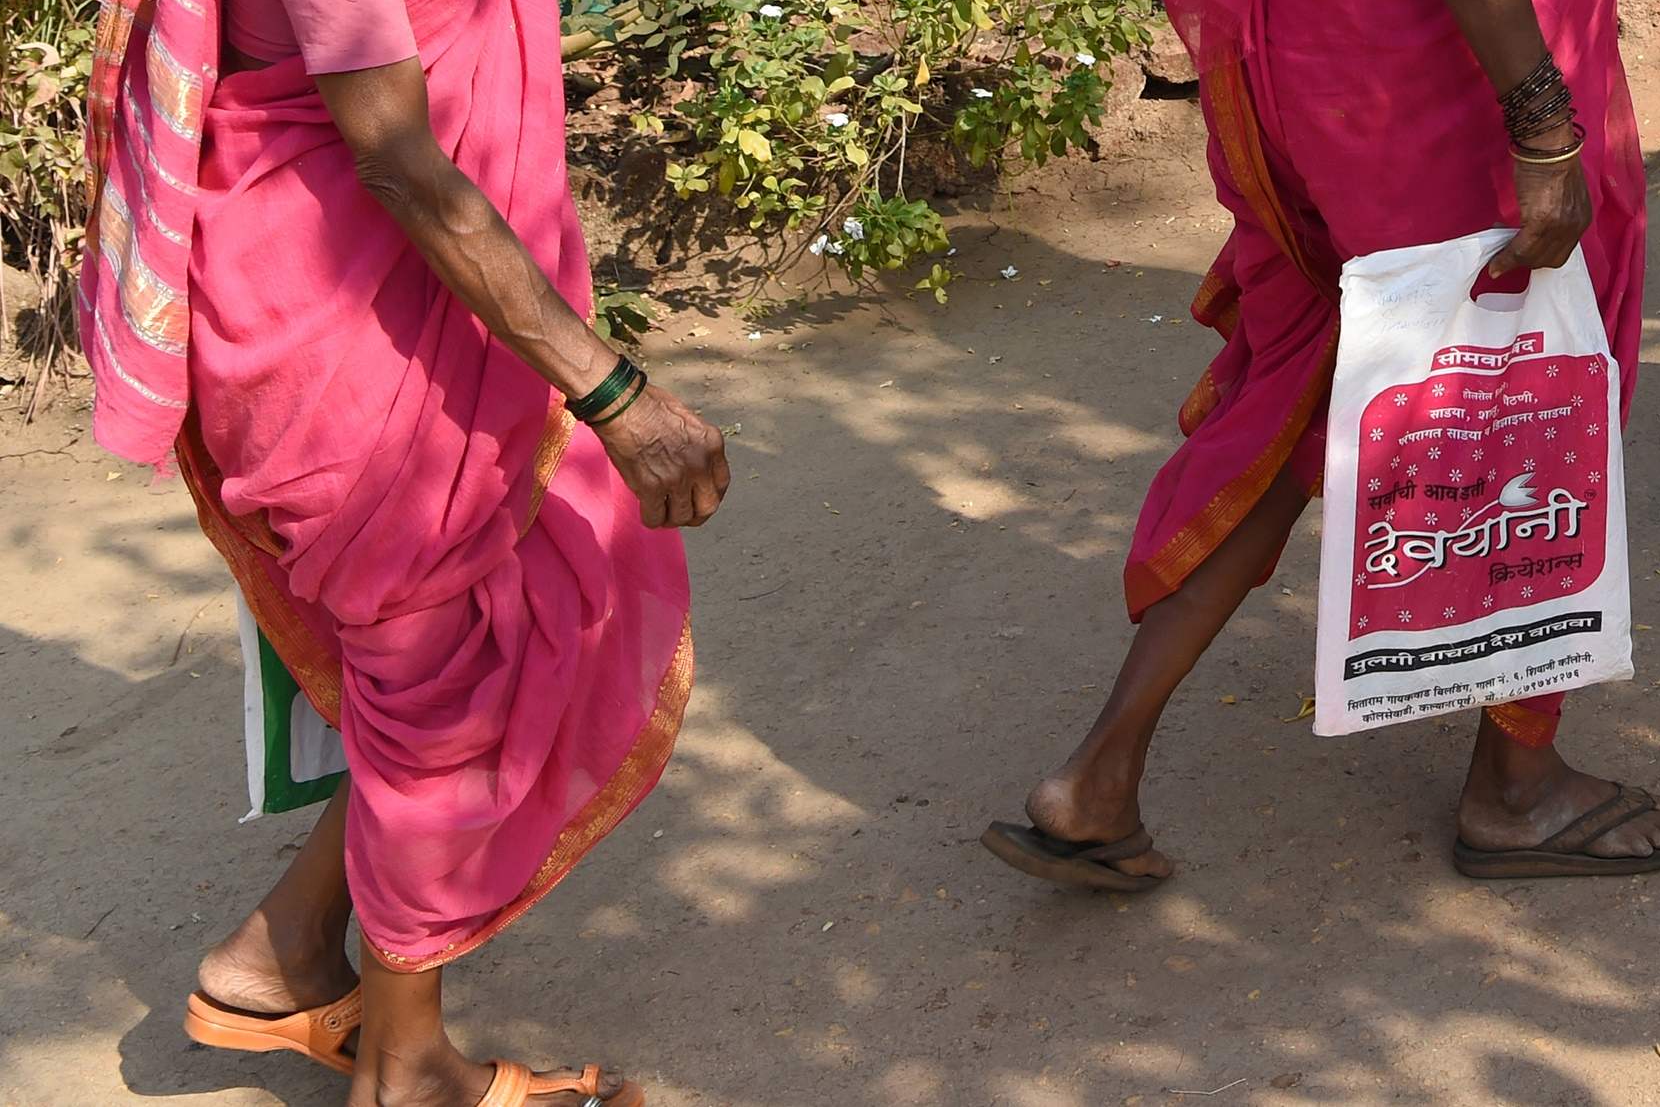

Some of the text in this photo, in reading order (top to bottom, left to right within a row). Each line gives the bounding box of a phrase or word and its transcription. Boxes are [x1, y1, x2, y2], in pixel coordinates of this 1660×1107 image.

[1436, 338, 1536, 367] सोमवार बंद
[1423, 477, 1486, 503] आवडती
[1364, 488, 1588, 576] देवयानी
[1351, 617, 1595, 674] मुलगी वाचवा देश वाचवा
